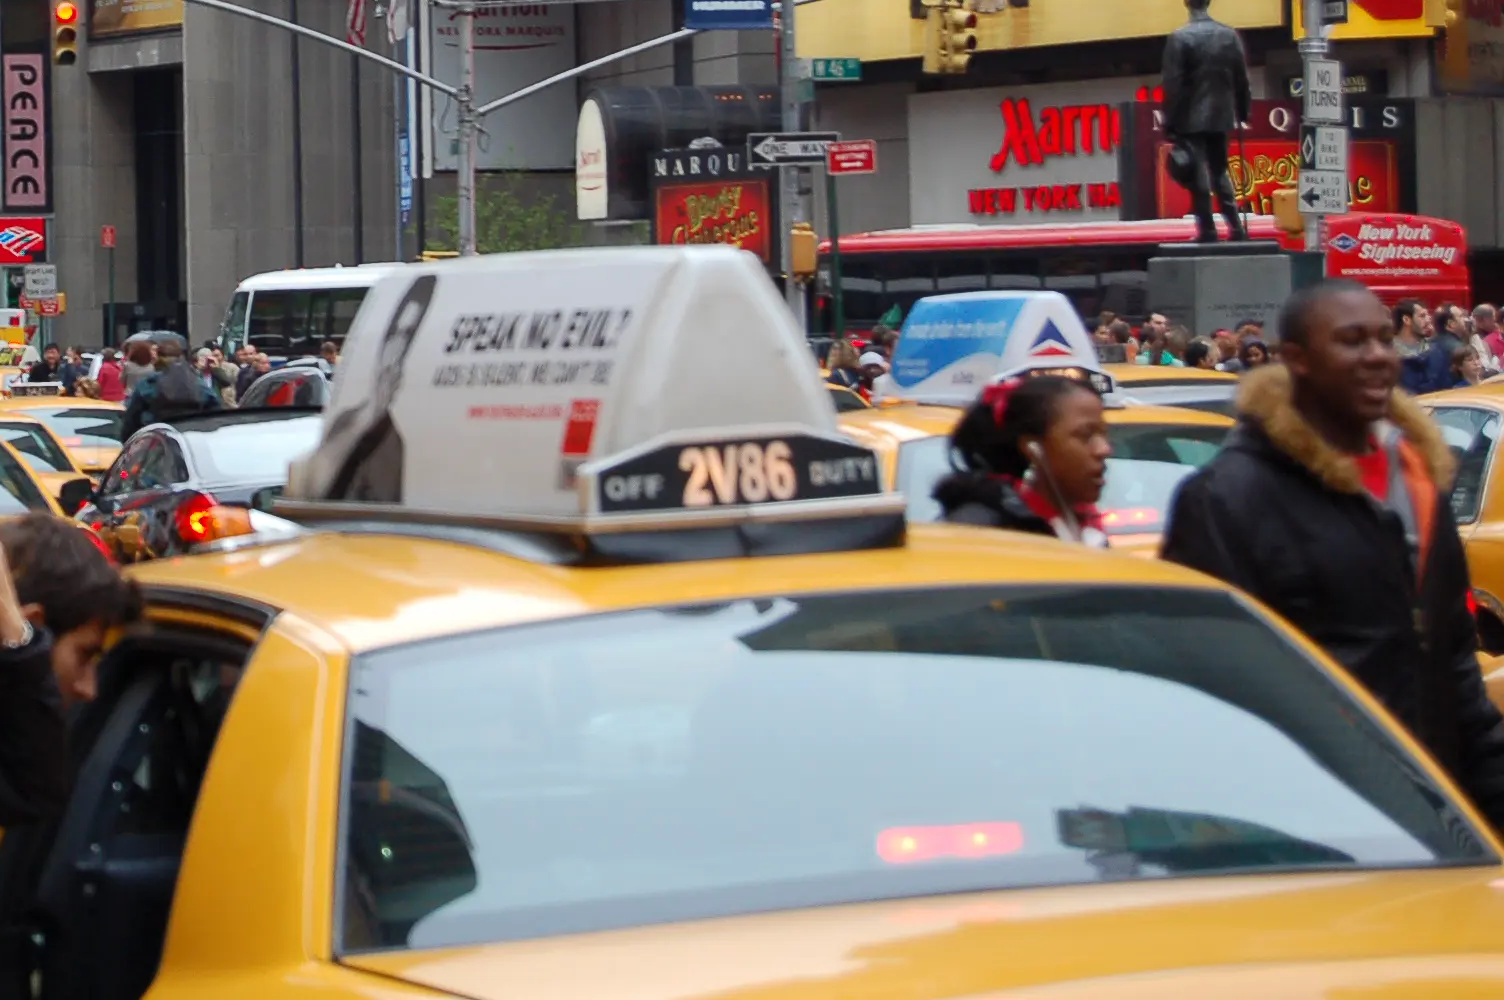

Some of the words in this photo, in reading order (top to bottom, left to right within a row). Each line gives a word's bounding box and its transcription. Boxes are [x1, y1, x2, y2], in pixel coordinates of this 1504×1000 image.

[506, 24, 566, 38] MARQUIS
[1316, 69, 1331, 87] NO
[1310, 90, 1338, 108] TURNS
[9, 64, 41, 196] PEACE
[762, 143, 788, 155] ONE
[800, 142, 828, 153] WAY
[968, 188, 1016, 215] NEW
[1020, 182, 1081, 212] YORK
[1358, 224, 1394, 240] New
[1396, 224, 1431, 240] York
[1358, 243, 1456, 265] Sightseeing
[444, 312, 521, 354] SPEAK
[525, 311, 561, 351] NO
[603, 473, 666, 501] OFF
[678, 440, 798, 508] 2V86
[807, 456, 875, 486] DUTY
